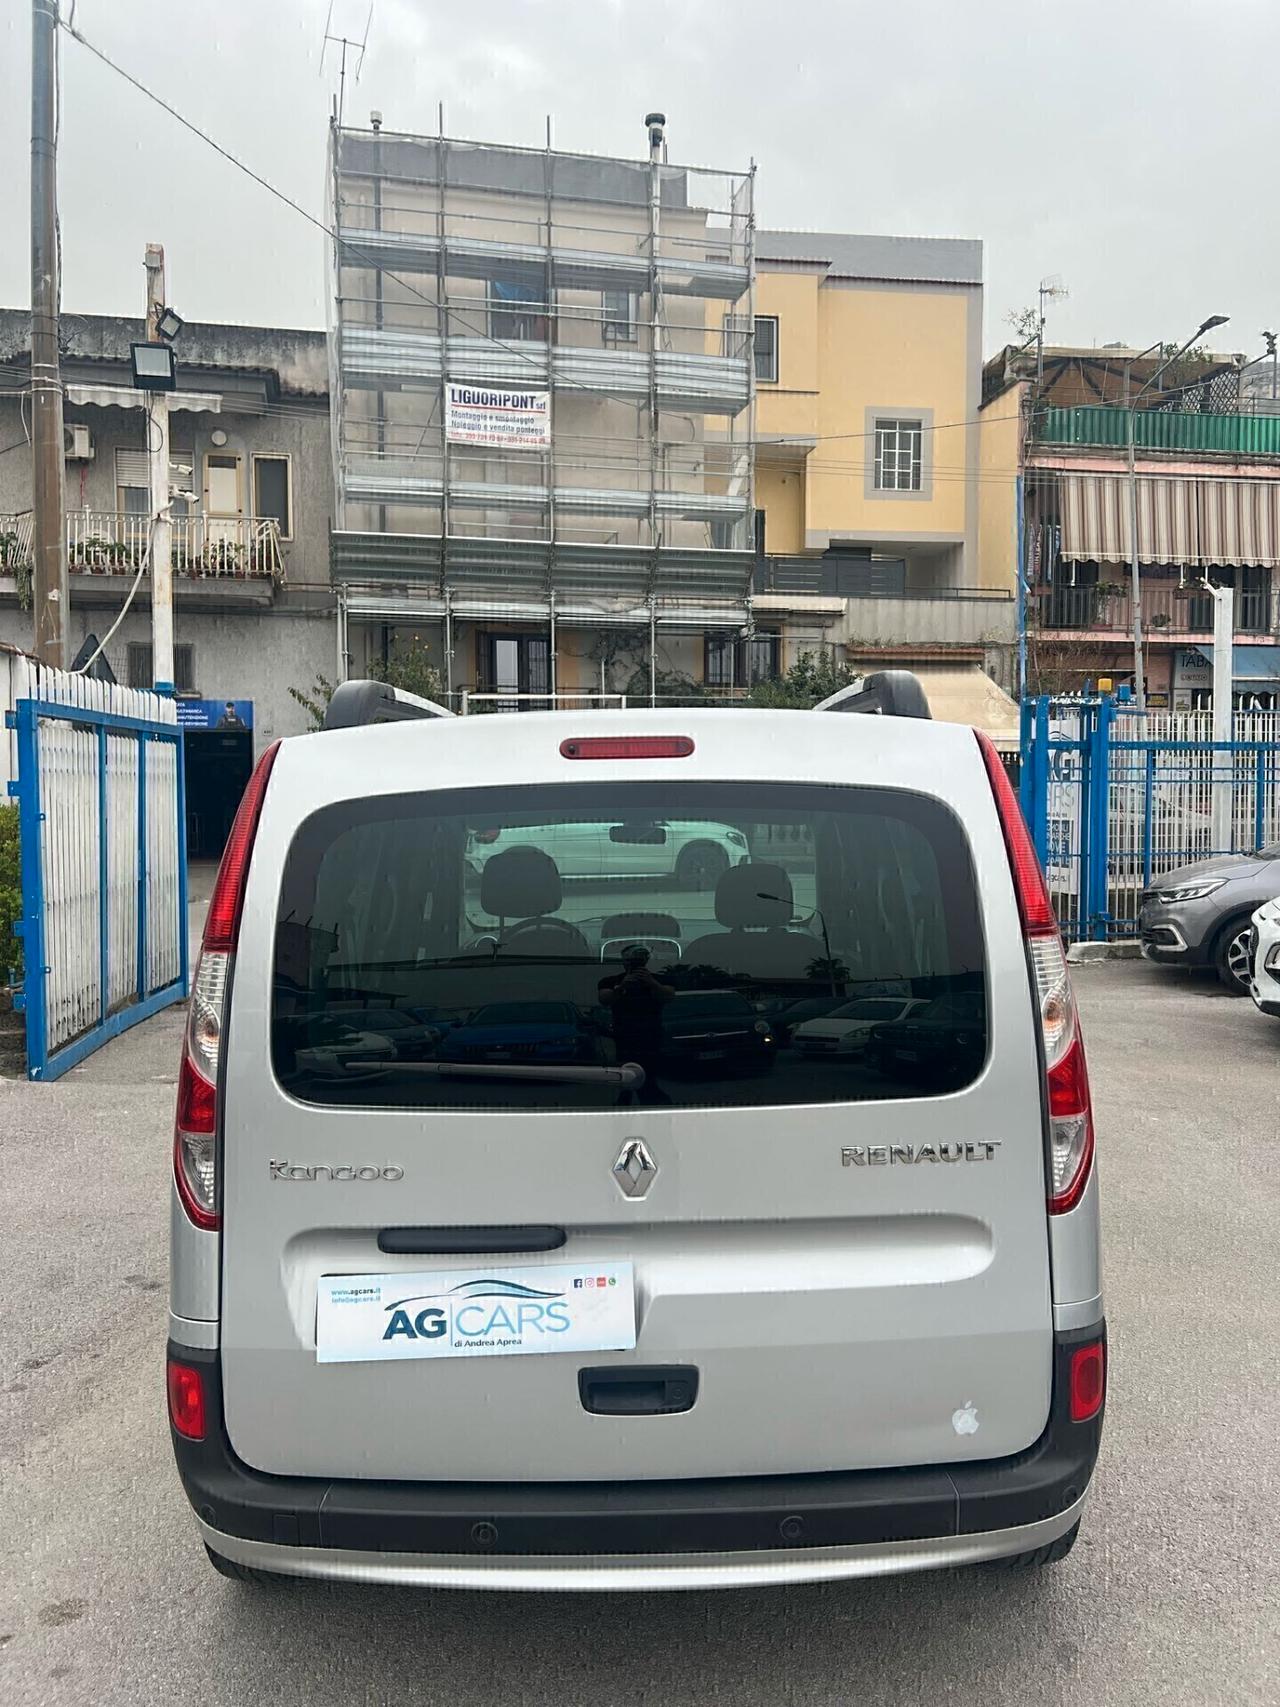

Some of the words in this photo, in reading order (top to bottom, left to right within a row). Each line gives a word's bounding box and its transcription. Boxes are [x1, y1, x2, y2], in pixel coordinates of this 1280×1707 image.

[451, 389, 536, 409] LIGUORIPONT
[451, 410, 487, 421] Montaggio
[451, 420, 481, 430] Noleggio
[490, 423, 514, 431] vendita
[516, 426, 546, 435] ponteggi
[841, 1140, 1001, 1167] RENAULT
[270, 1158, 404, 1181] Kangoo
[383, 1308, 447, 1340] AG
[455, 1302, 570, 1336] CARS
[454, 1340, 462, 1348] di
[464, 1338, 495, 1347] Andrea
[497, 1338, 522, 1346] Aprea
